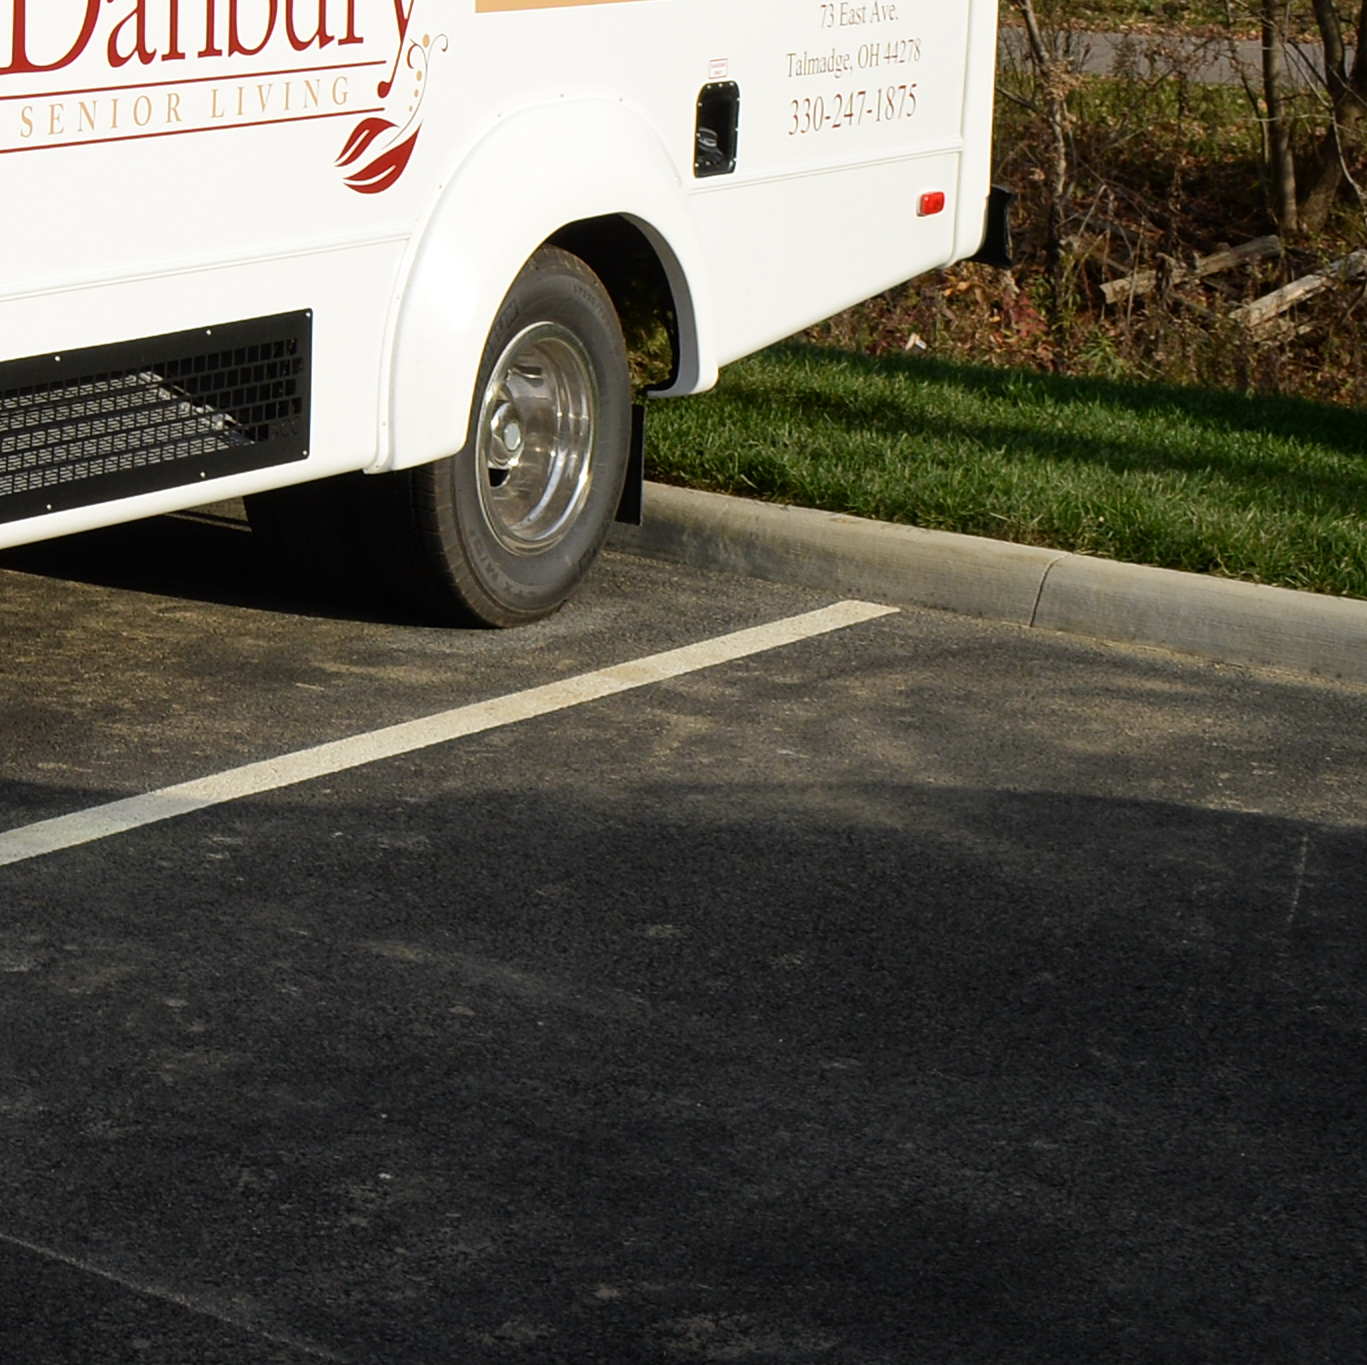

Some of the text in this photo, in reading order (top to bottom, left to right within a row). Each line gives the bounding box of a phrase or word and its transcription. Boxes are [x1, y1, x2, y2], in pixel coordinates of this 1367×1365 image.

[819, 0, 899, 29] 73 East Ave.
[786, 37, 922, 79] Talmadge, OH 44278
[19, 75, 350, 138] SENIOR LIVING
[787, 82, 918, 136] 330-247-1875
